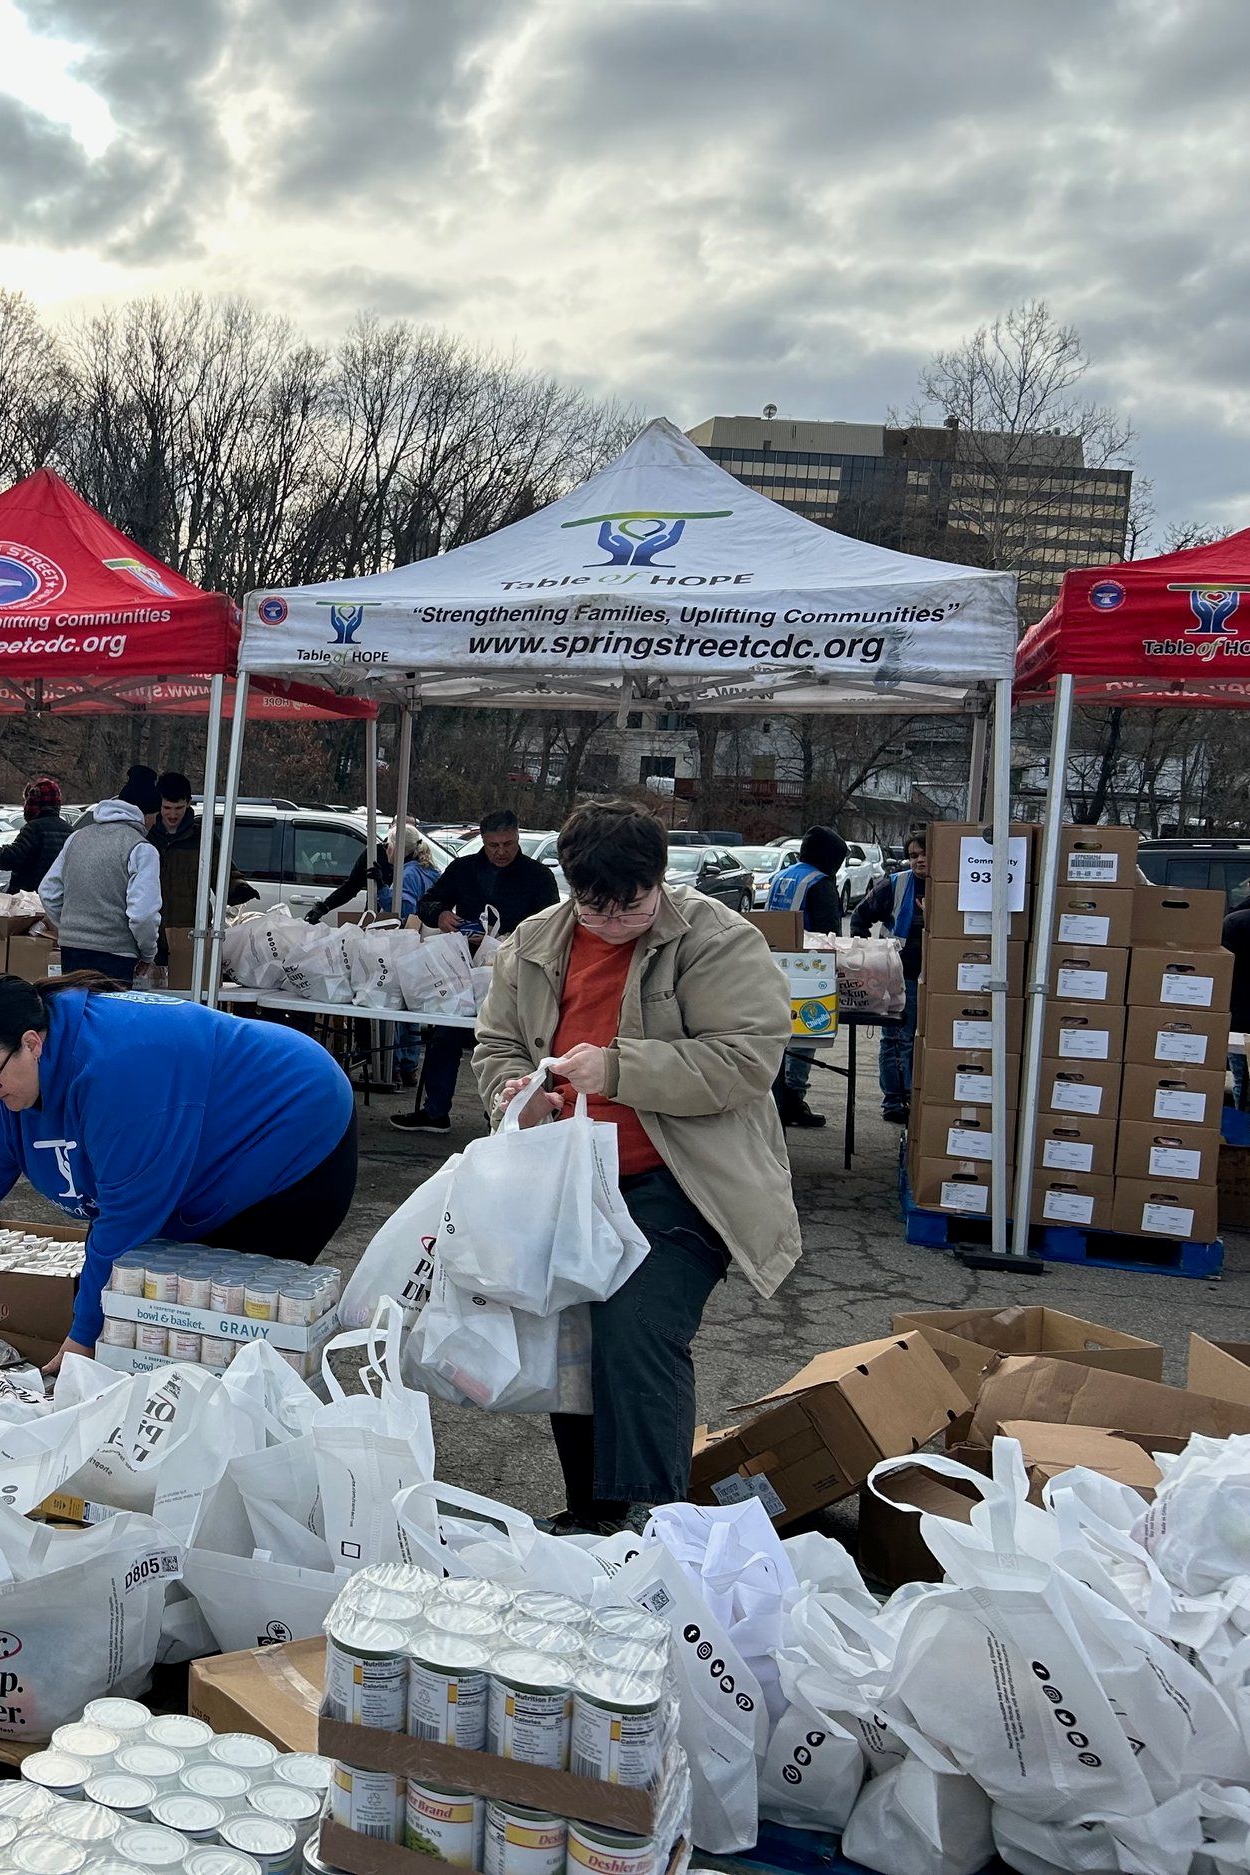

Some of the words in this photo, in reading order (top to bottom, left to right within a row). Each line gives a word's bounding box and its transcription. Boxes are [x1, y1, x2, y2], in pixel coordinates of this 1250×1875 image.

[7, 546, 59, 582] STREET
[501, 573, 591, 591] Table
[598, 572, 650, 588] of
[650, 573, 754, 586] HOPE
[55, 608, 172, 628] Communities
[575, 605, 671, 626] Families,
[679, 606, 776, 628] Uplifting
[469, 630, 886, 663] www.springstreetcdc.org
[1143, 639, 1195, 657] Table
[1196, 637, 1227, 662] of
[297, 649, 331, 662] Table
[333, 651, 348, 665] of
[352, 651, 389, 663] HOPE
[970, 871, 1013, 884] 939
[805, 1013, 831, 1028] Chiquita
[137, 1309, 159, 1321] bowl
[160, 1312, 170, 1323] &
[220, 1320, 270, 1339] GRAVY
[132, 1359, 154, 1372] bowl
[125, 1557, 160, 1590] D805
[363, 1660, 392, 1668] Nutrition
[514, 1692, 547, 1703] Nutrition
[513, 1715, 541, 1725] Calories
[418, 1800, 453, 1818] Brand
[588, 1855, 634, 1873] Deshler
